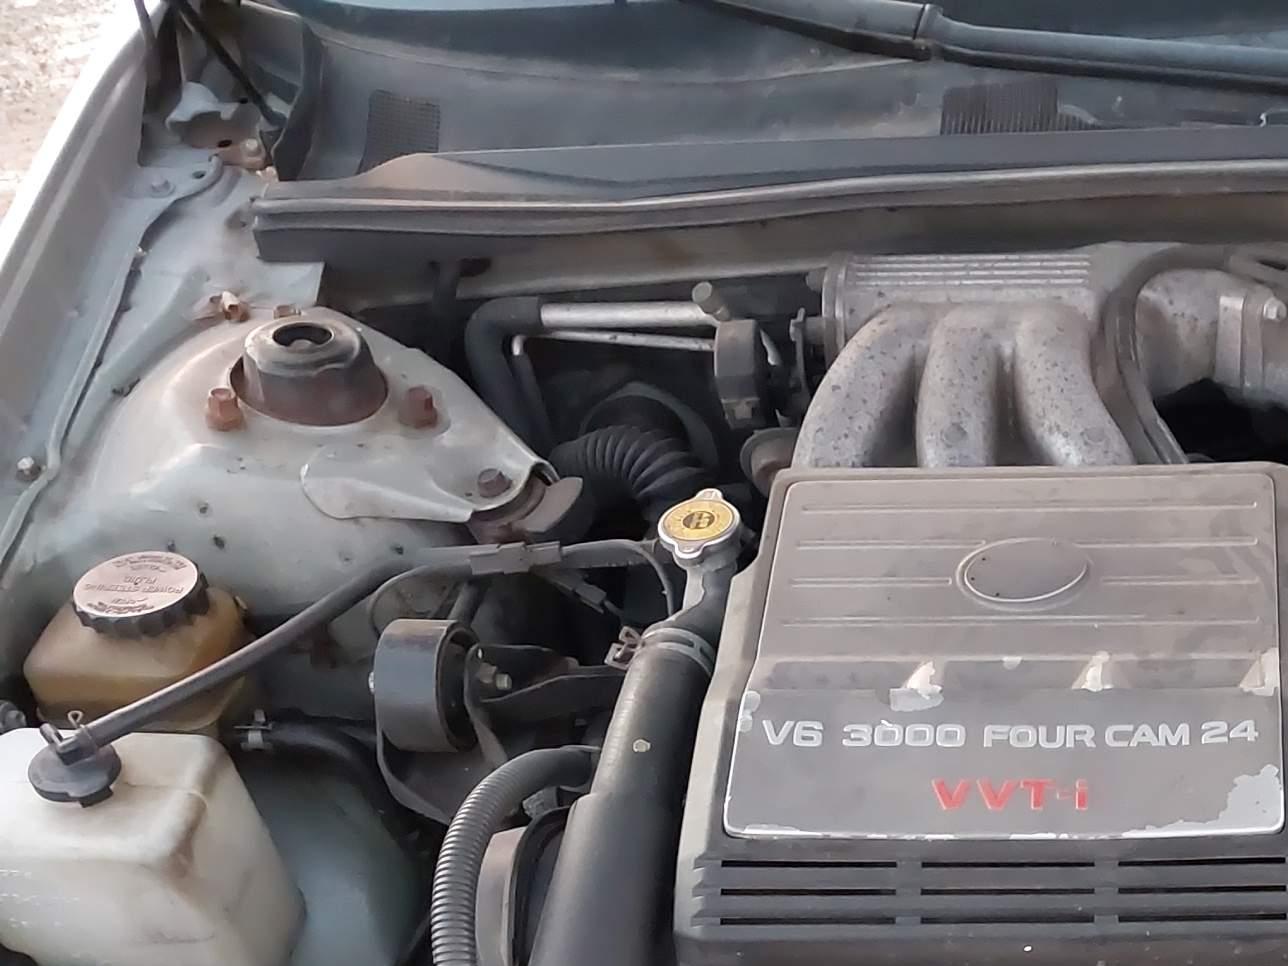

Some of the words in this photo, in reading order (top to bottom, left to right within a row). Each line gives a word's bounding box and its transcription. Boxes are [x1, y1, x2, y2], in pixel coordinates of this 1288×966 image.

[762, 719, 824, 747] V6
[842, 723, 966, 748] 3000
[983, 723, 1097, 748] FOUR
[1105, 722, 1190, 748] CAM
[1201, 719, 1259, 745] 24
[931, 777, 1089, 811] VVT-i
